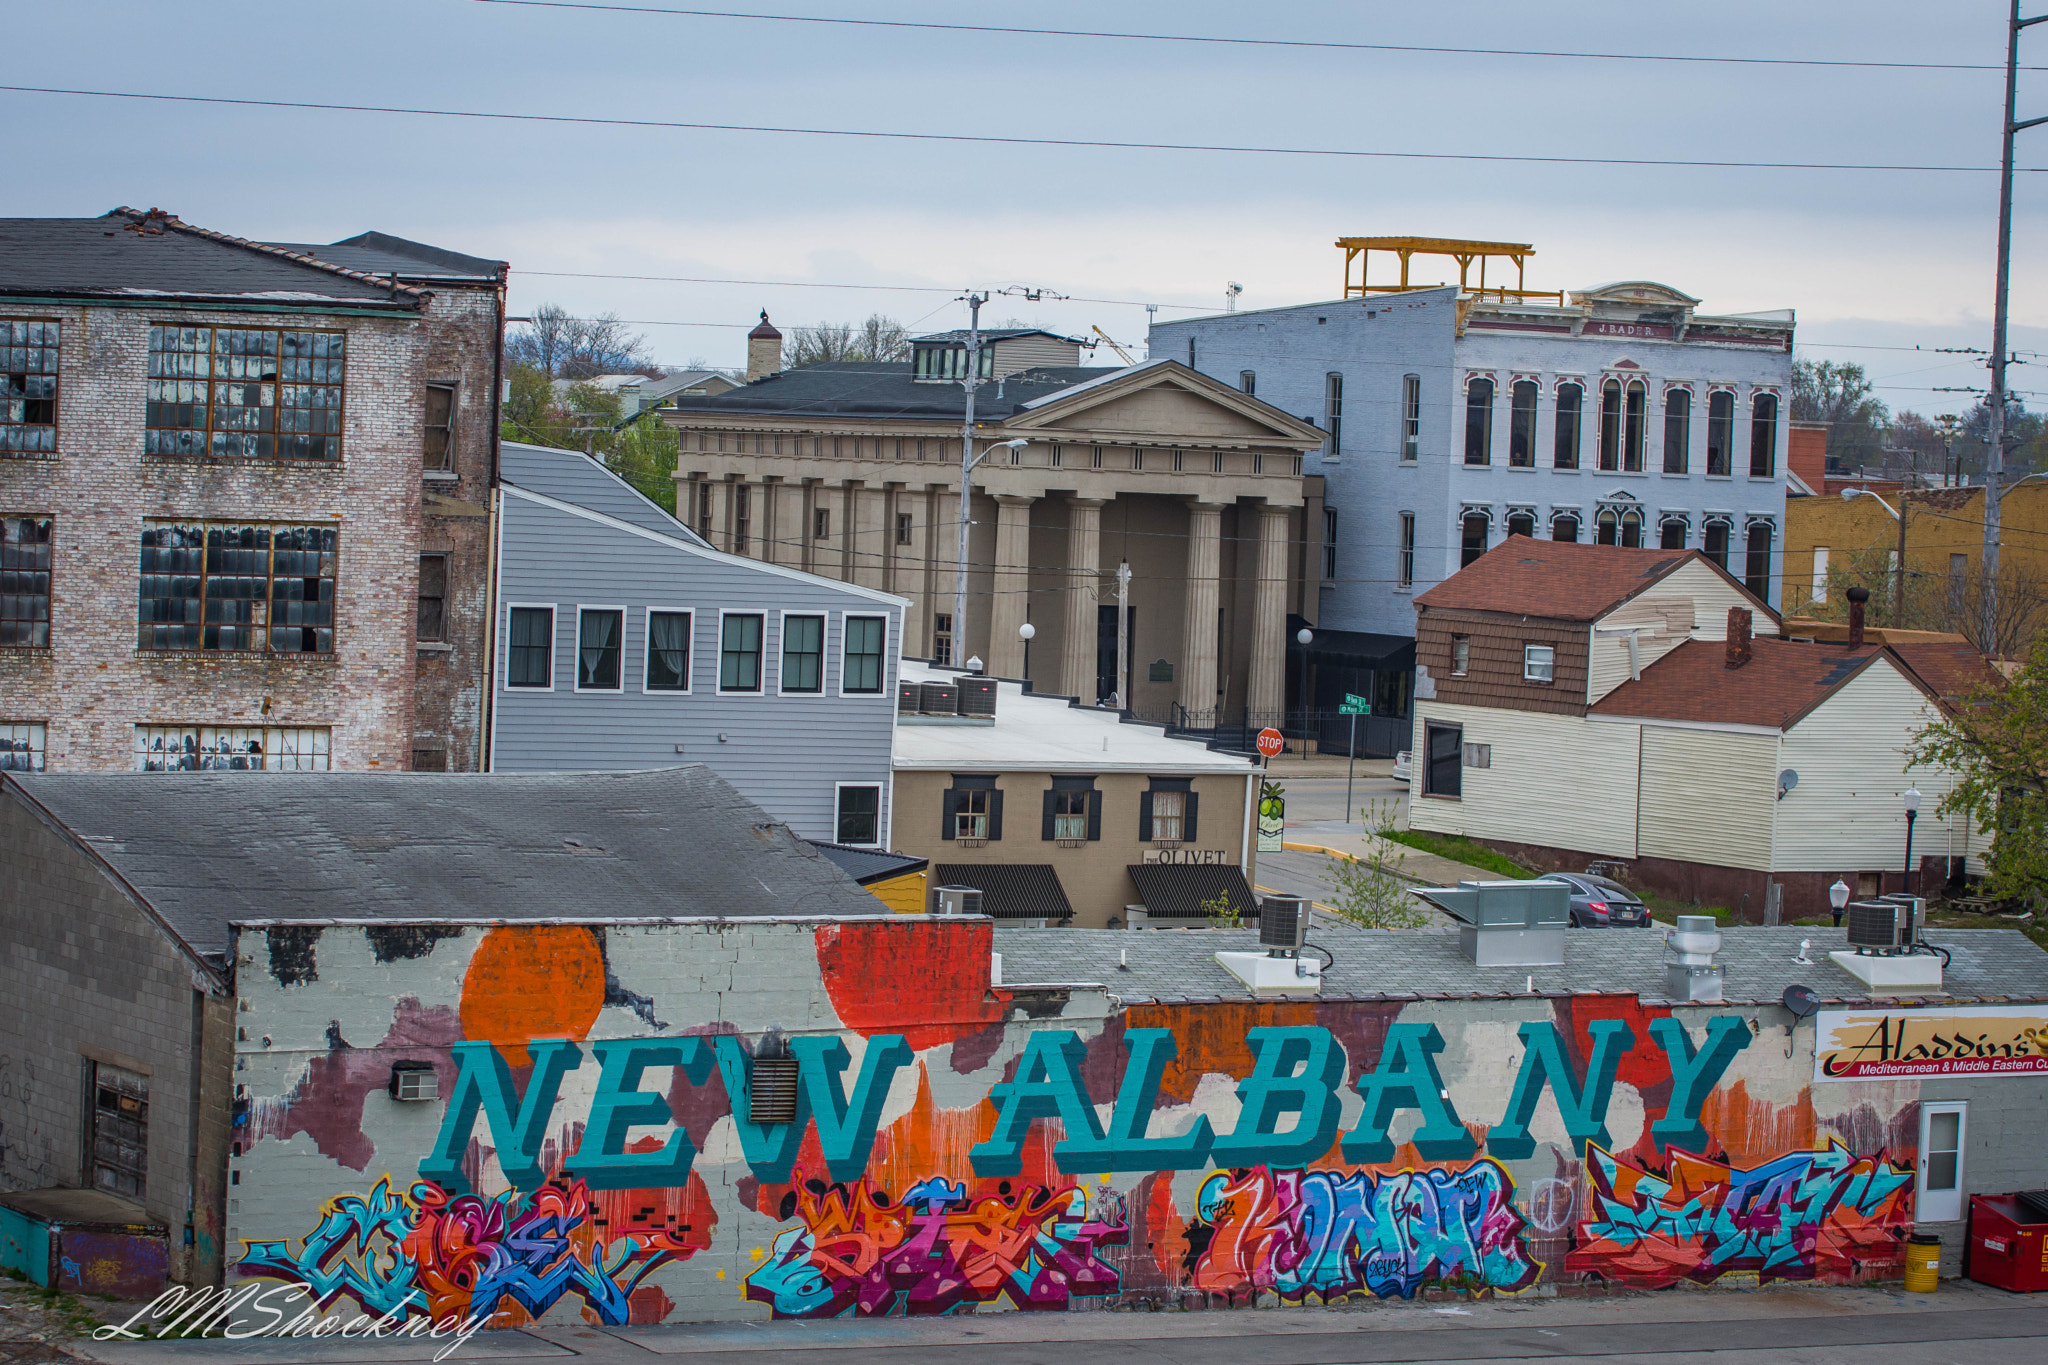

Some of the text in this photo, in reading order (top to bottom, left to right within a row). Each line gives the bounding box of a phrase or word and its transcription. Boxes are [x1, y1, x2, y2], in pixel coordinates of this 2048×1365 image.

[1258, 736, 1282, 749] STOP
[1159, 850, 1226, 864] OLIVET
[1822, 1015, 2030, 1077] Aladdin's
[1858, 1062, 1939, 1075] Mediterranean
[1942, 1061, 1950, 1072] &
[1952, 1060, 1990, 1072] Middle
[1992, 1059, 2033, 1071] Eastern
[418, 1016, 1753, 1191] NEW ALBANY
